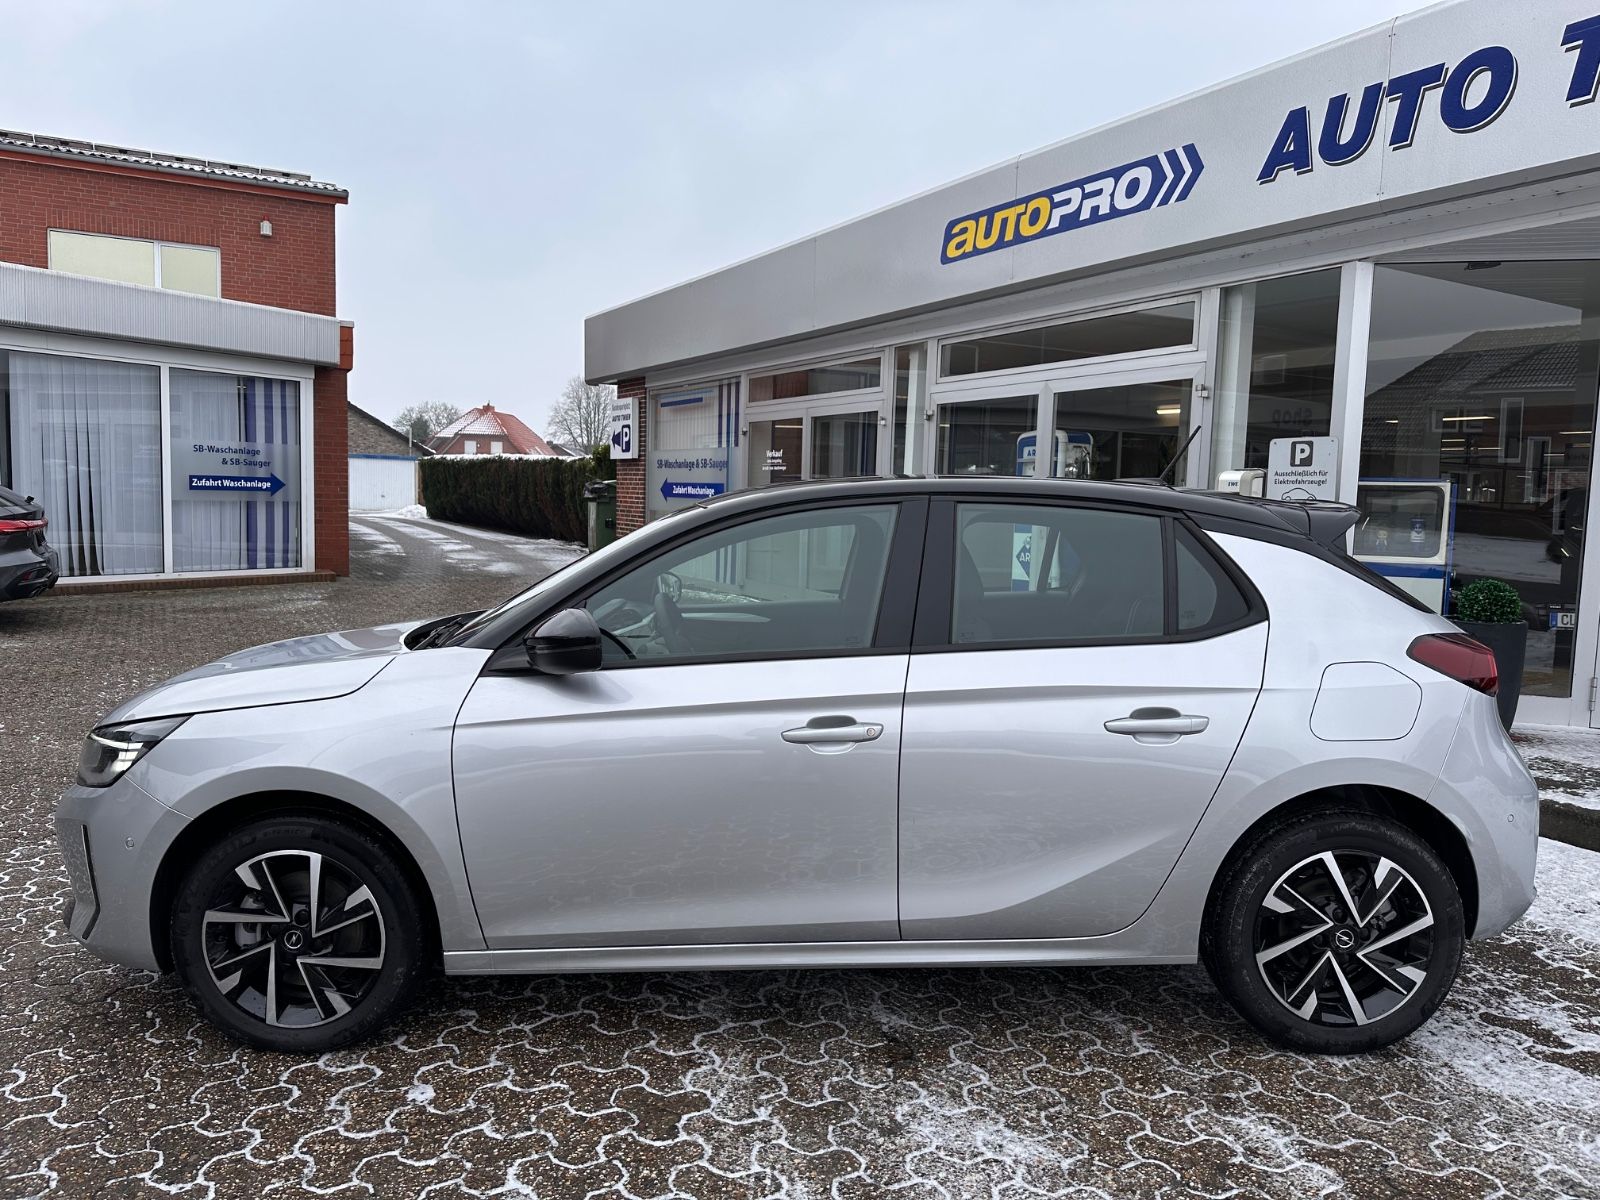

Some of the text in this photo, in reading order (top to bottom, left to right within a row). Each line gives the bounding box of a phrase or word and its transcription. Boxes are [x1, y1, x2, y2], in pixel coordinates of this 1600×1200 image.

[1256, 45, 1519, 185] AUTO
[622, 427, 630, 451] P
[193, 444, 261, 457] SB-Waschanlage
[1294, 443, 1311, 465] P
[229, 458, 272, 468] SB-Sauger
[656, 458, 695, 471] SB-Waschanlage
[695, 459, 700, 468] &
[192, 478, 271, 489] Zufahrt Waschanlage
[1274, 478, 1328, 487] Elektrofahrzeuge!
[672, 485, 715, 497] Zufahrt Waschanlage
